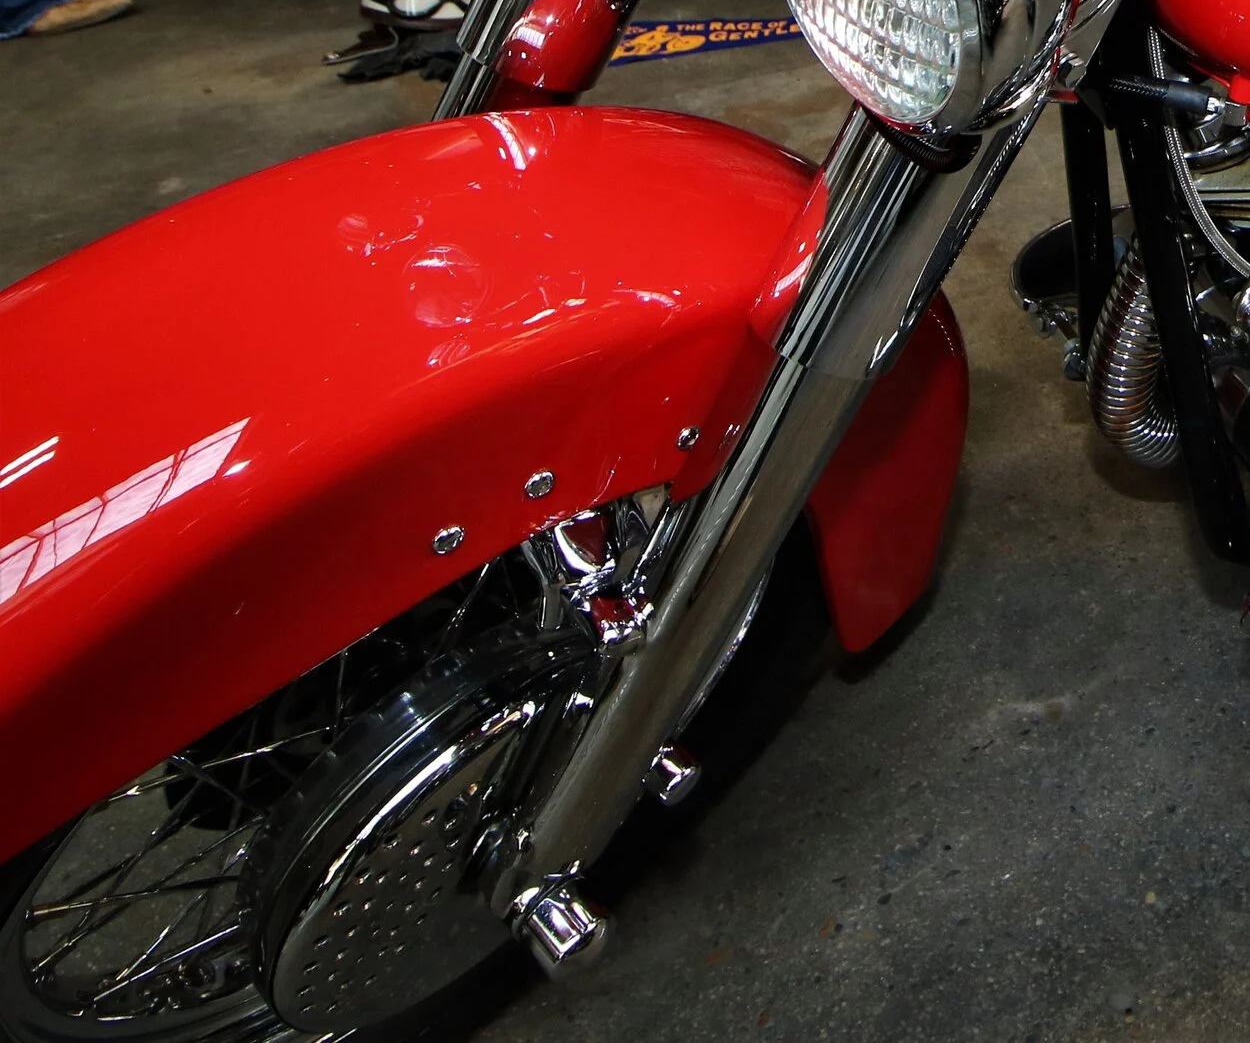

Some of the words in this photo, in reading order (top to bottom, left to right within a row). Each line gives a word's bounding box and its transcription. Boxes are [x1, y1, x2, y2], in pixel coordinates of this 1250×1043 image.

[676, 24, 705, 32] THE
[709, 22, 763, 31] RACE
[768, 21, 788, 29] OF
